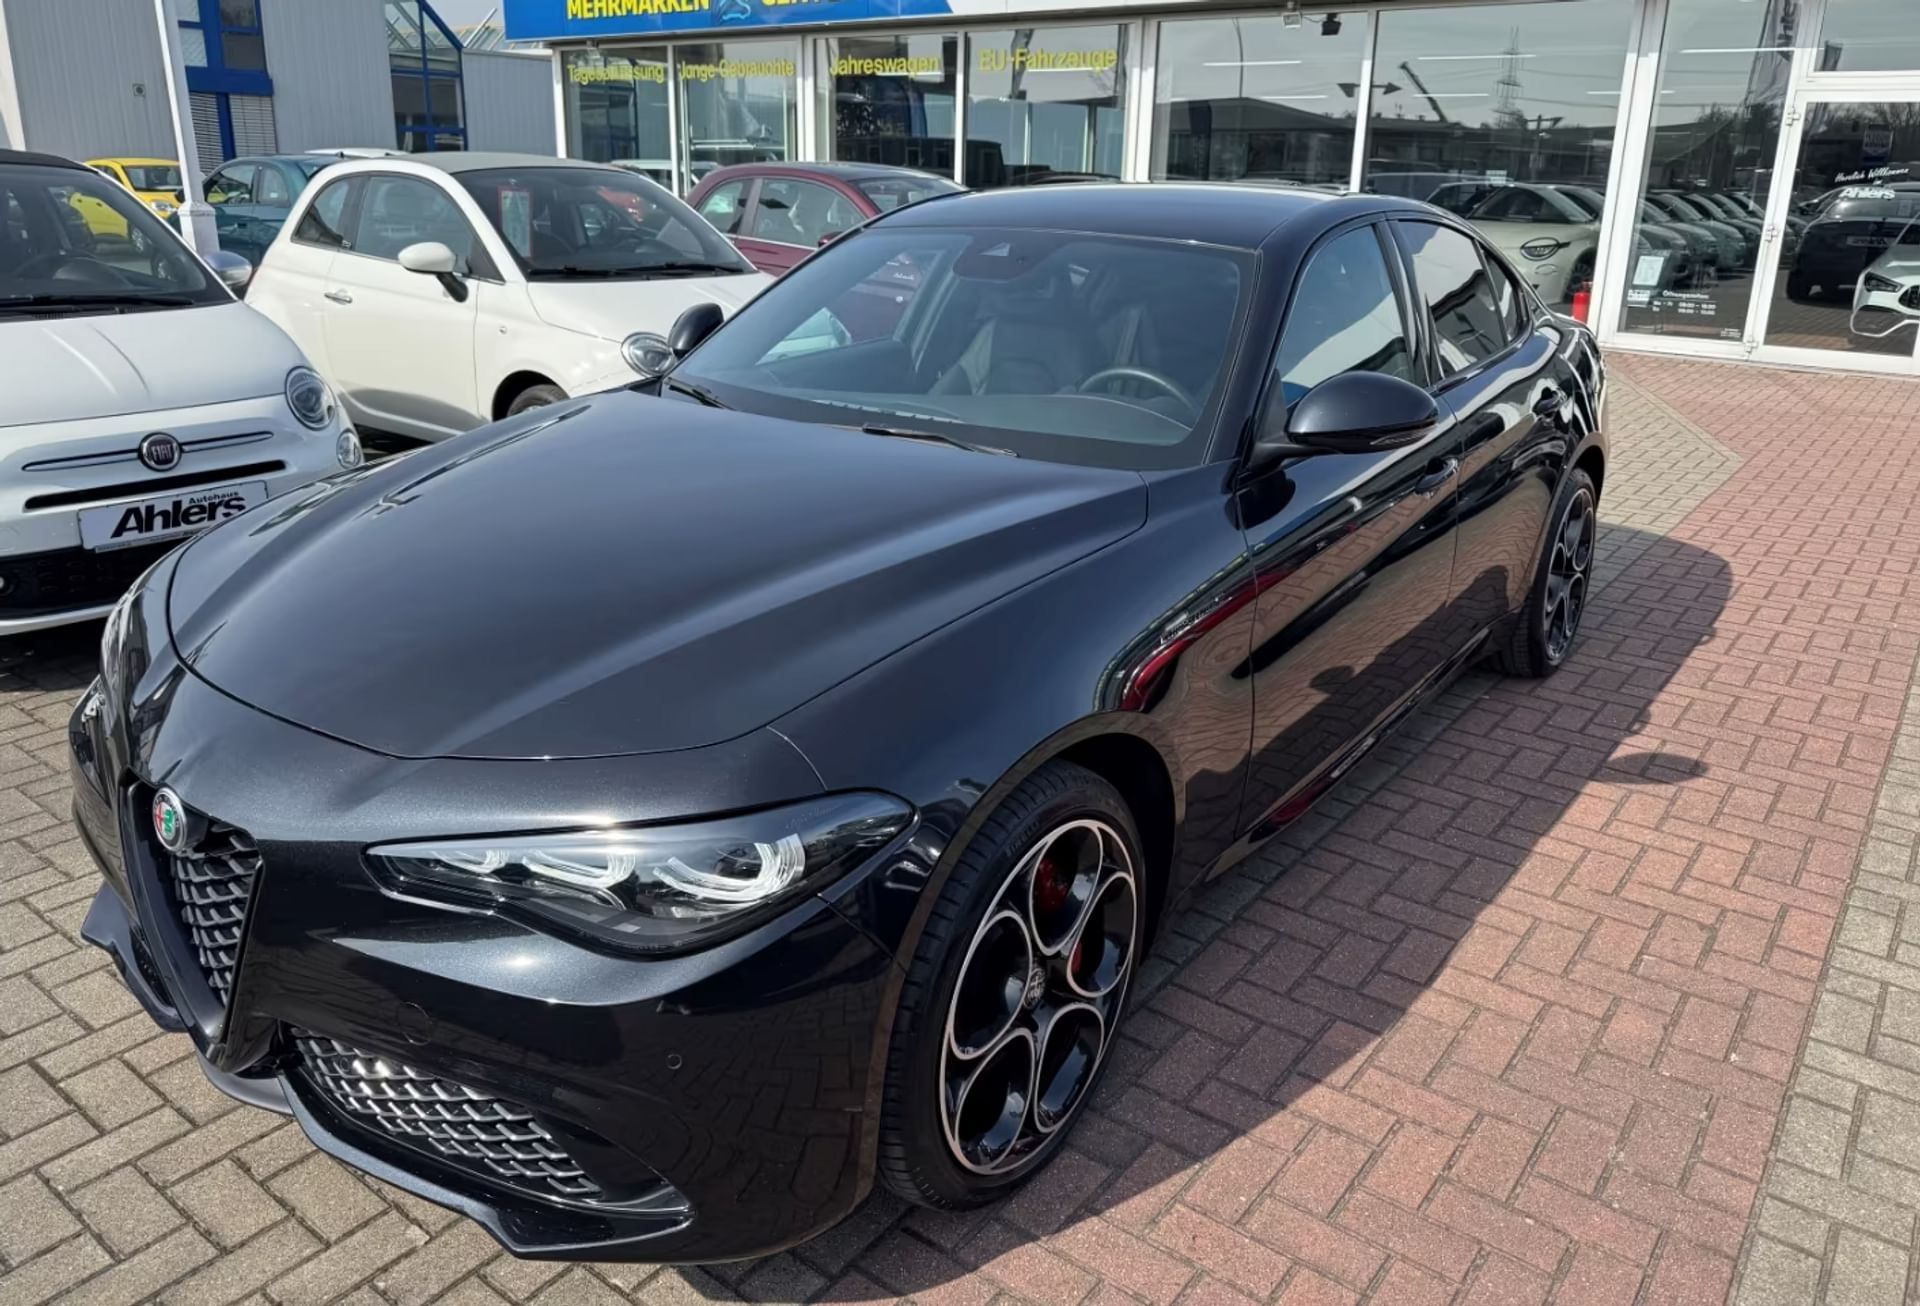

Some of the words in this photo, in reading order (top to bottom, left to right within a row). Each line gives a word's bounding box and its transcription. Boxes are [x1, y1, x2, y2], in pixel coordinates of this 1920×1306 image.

[830, 54, 939, 79] Jahreswagen
[979, 47, 1118, 76] EU-Fahrzeuge
[150, 444, 172, 461] FIAT
[188, 491, 240, 505] Autohaus
[110, 496, 247, 539] Ahlers
